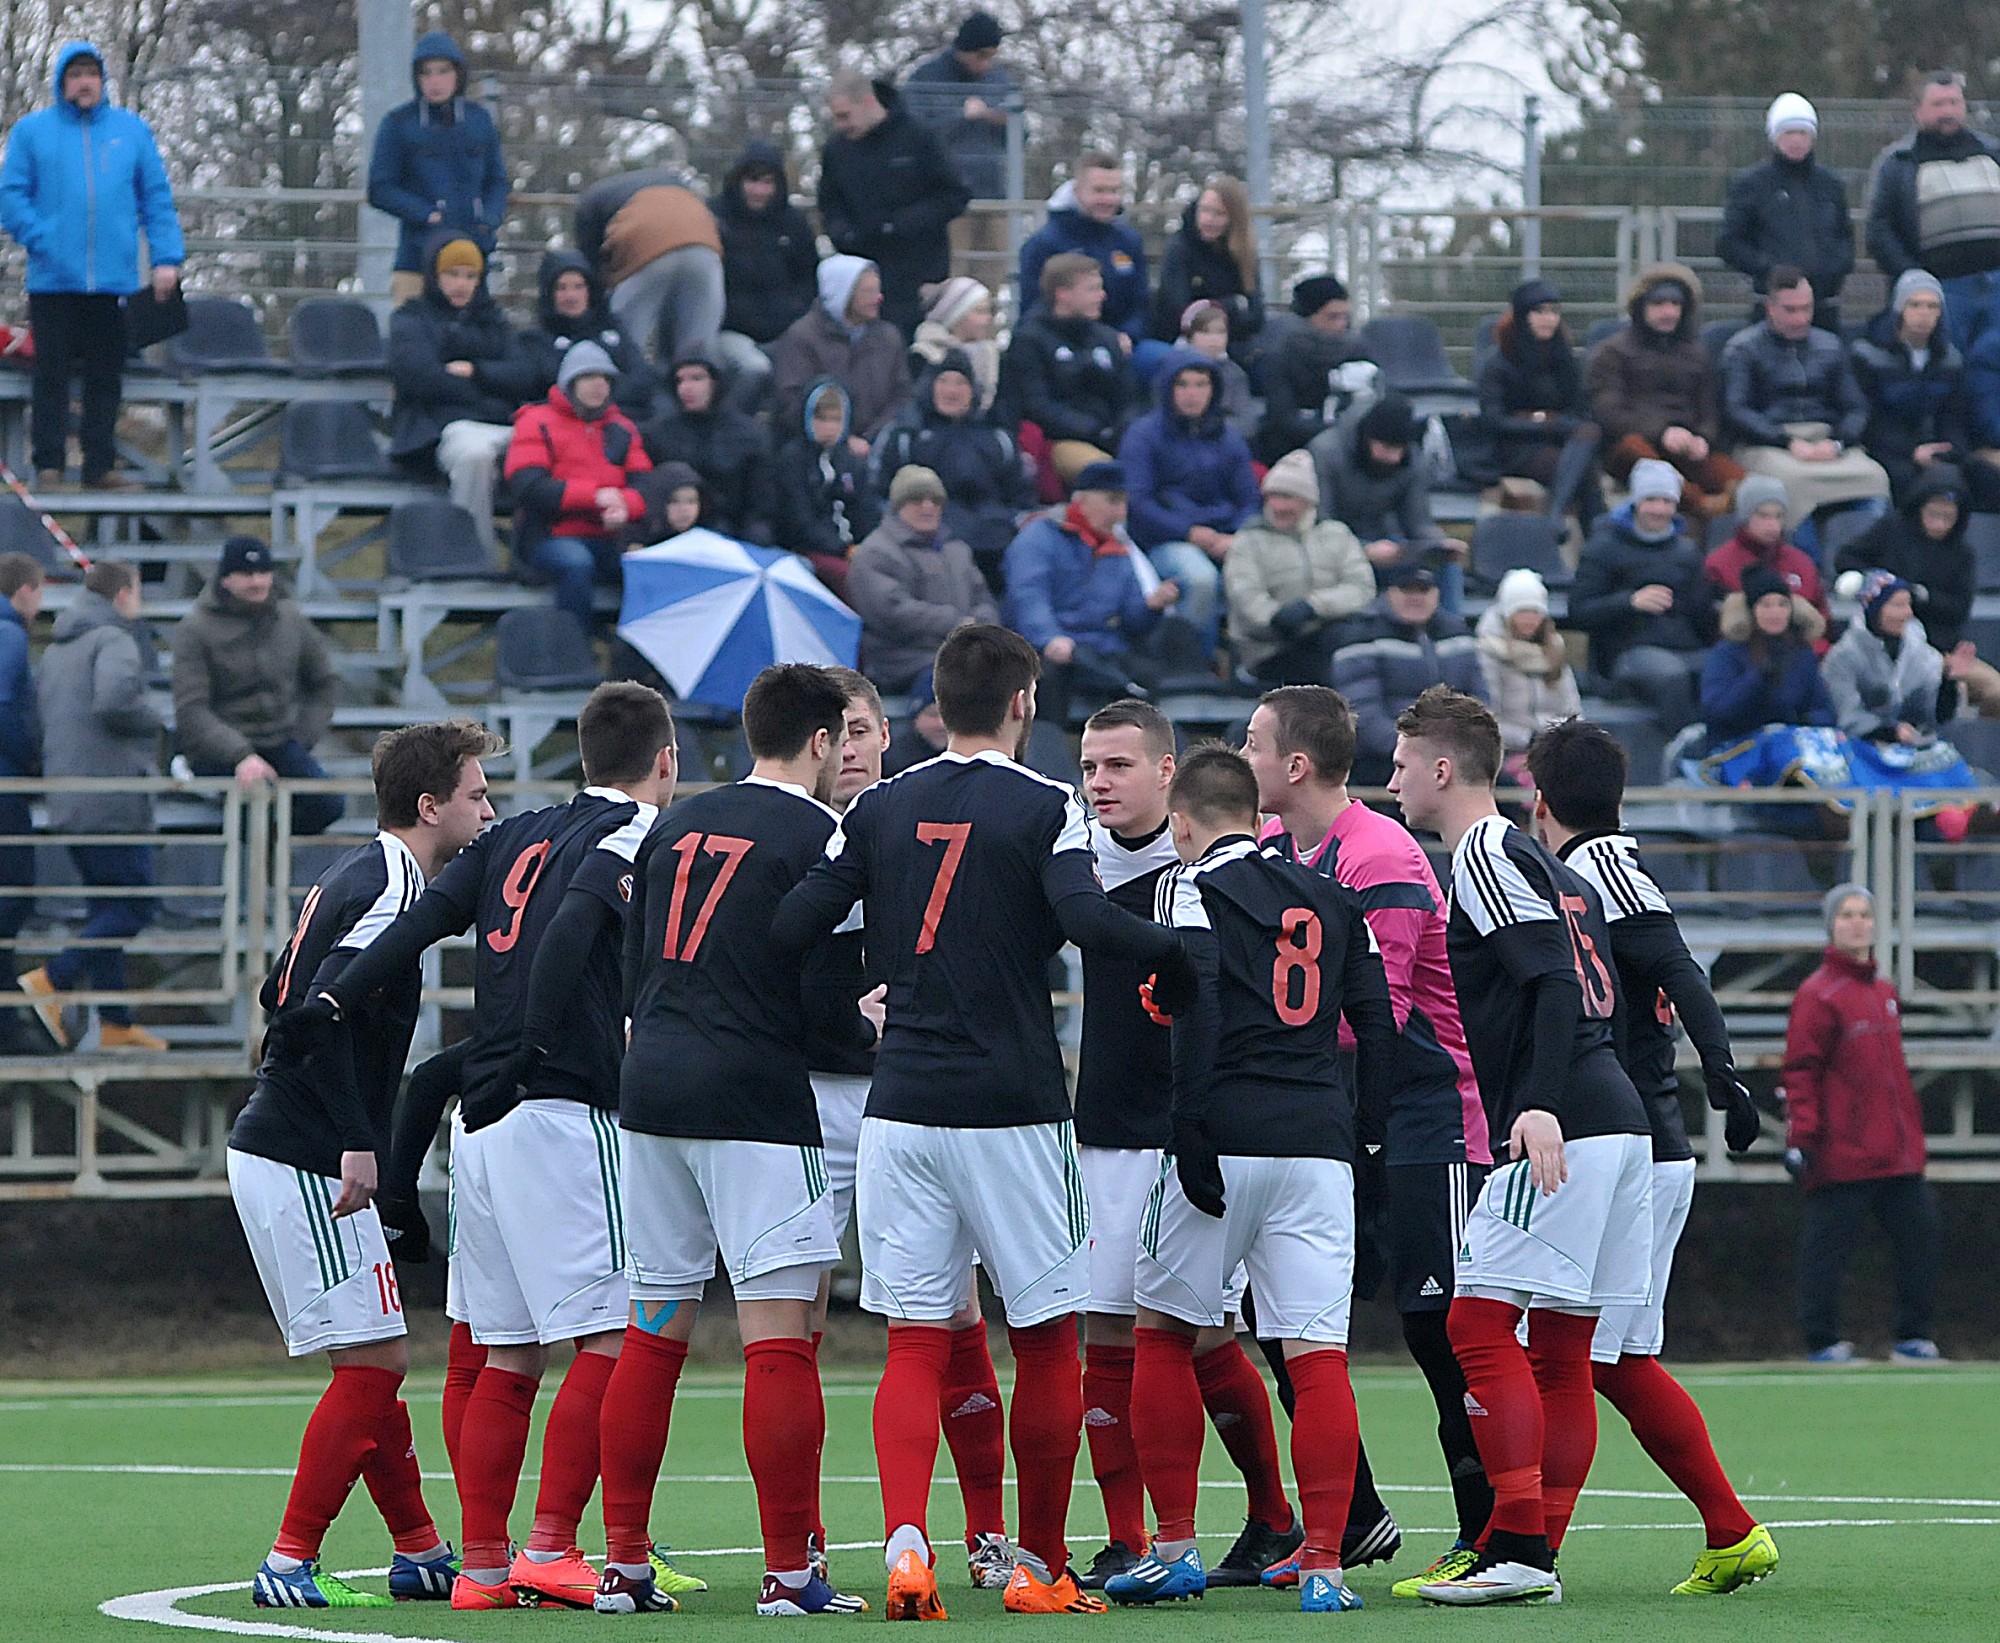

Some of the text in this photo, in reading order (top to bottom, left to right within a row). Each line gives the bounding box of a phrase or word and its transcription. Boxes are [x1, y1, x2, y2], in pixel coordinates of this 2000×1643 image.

[487, 838, 552, 953] 9
[663, 831, 755, 962] 17
[915, 821, 973, 955] 7
[1272, 907, 1323, 1026] 8
[1559, 891, 1615, 1018] 15
[372, 1261, 401, 1315] 18
[1420, 1287, 1444, 1296] adidas
